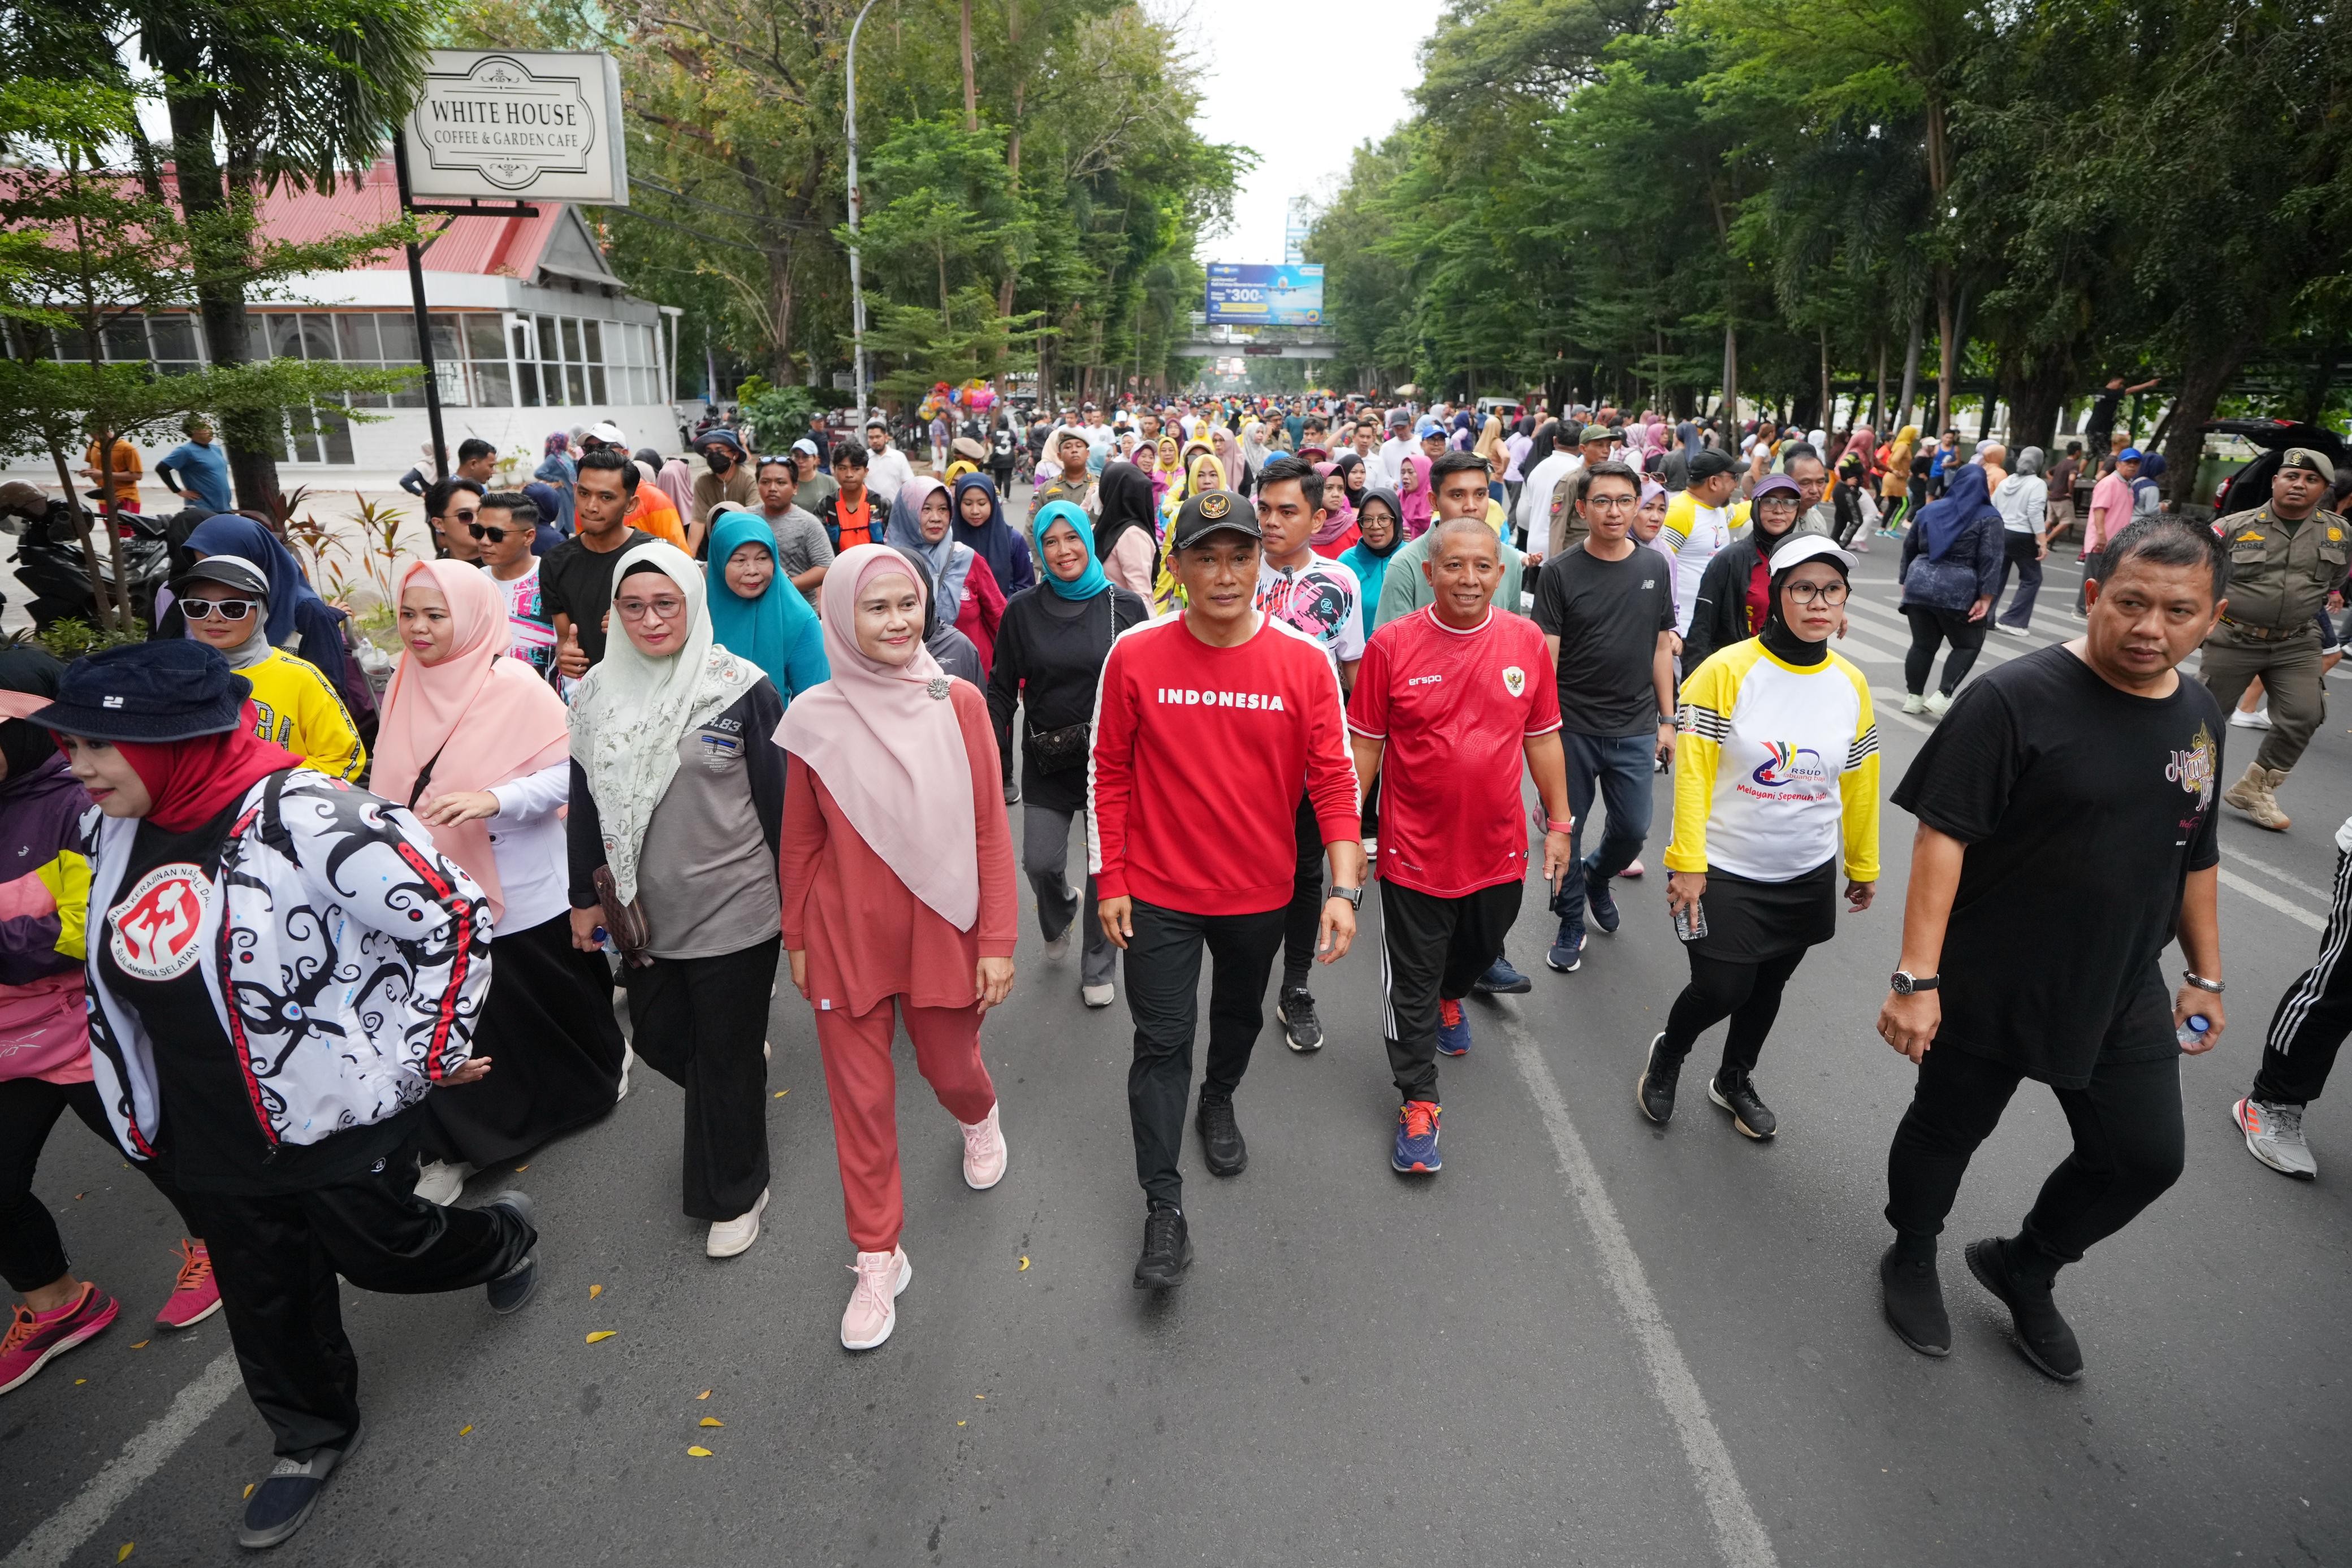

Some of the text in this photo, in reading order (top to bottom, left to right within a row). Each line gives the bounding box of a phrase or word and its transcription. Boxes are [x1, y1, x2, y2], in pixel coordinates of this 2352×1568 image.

[431, 100, 577, 126] WHITE HOUSE
[434, 130, 578, 147] COFFEE & GARDEN CAFE
[995, 431, 1011, 454] 3
[1409, 674, 1442, 686] erspo
[1158, 688, 1284, 711] INDONESIA
[2165, 744, 2210, 793] Hard
[1737, 784, 1827, 802] Melayani Sepenuh Hati
[131, 869, 177, 903] KERAJINAN
[115, 943, 200, 977] SULAWESI SELATAN
